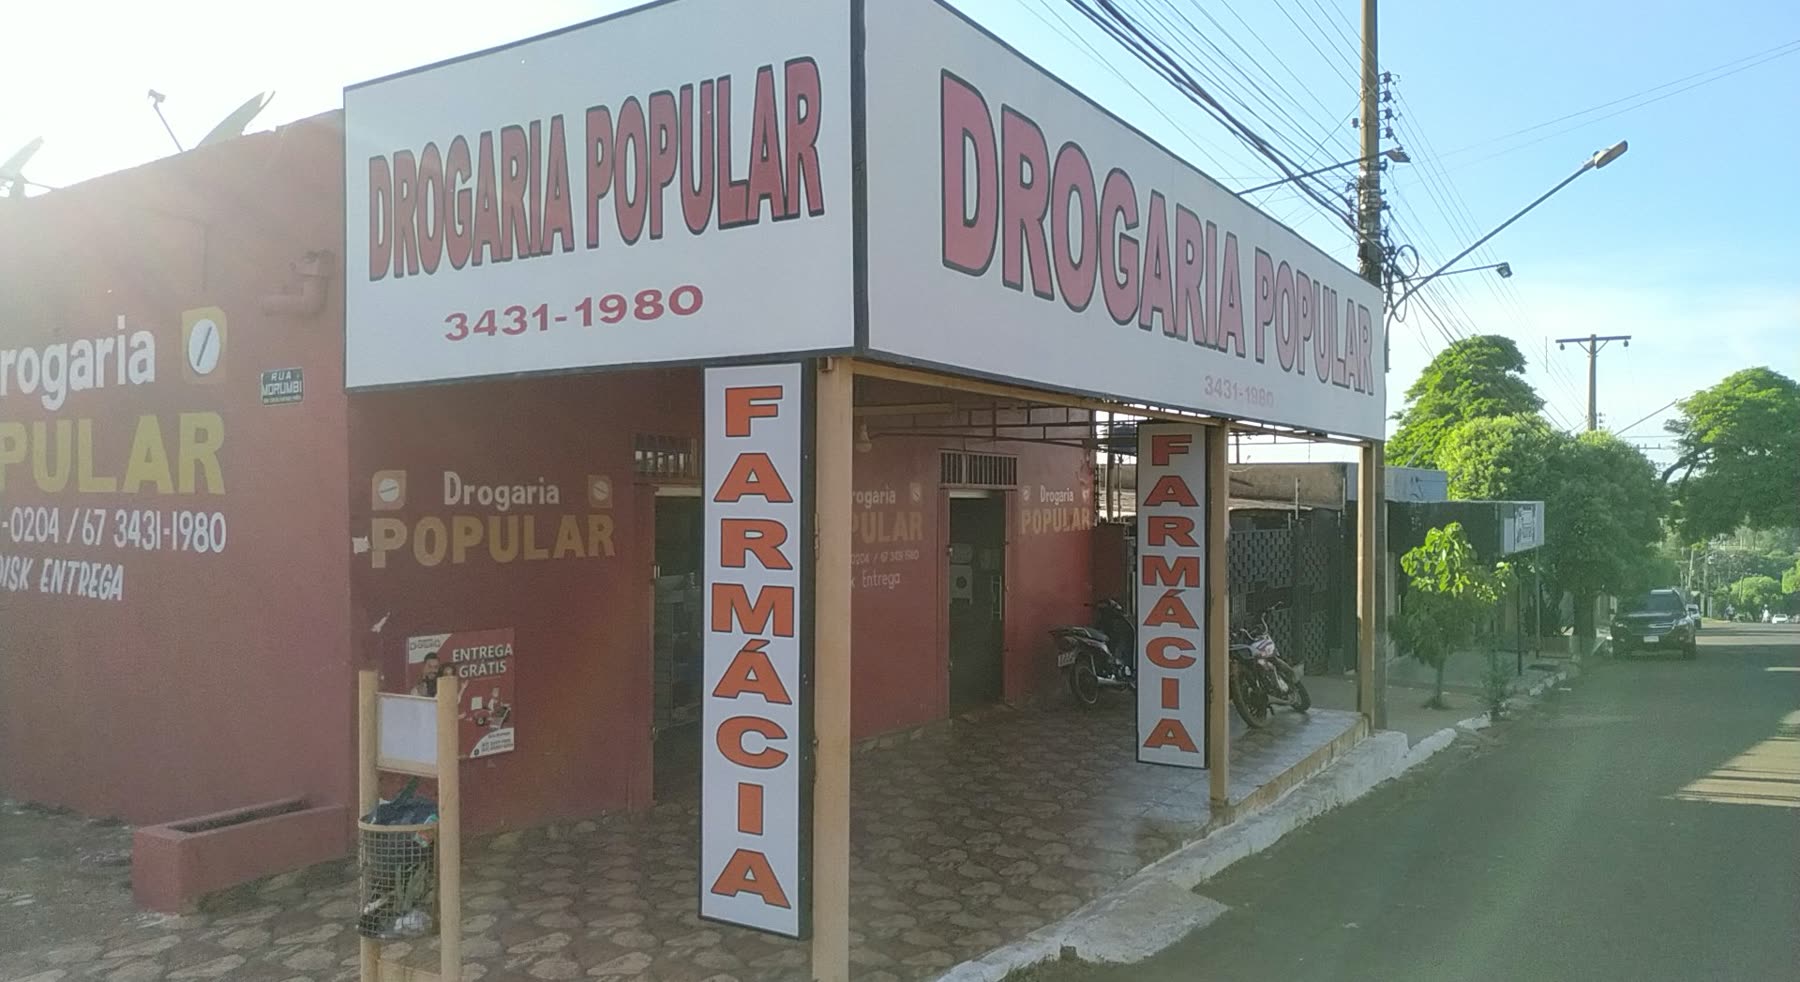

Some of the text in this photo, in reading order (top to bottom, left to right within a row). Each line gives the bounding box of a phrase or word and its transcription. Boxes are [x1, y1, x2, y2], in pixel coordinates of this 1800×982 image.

[368, 55, 826, 281] DROGARIA POPULAR
[940, 67, 1375, 397] DROGARIA POPULAR
[444, 285, 705, 342] 3431-1980
[271, 371, 292, 381] RUA
[443, 471, 561, 511] Drogaria
[1040, 485, 1074, 506] Drogaria
[113, 508, 227, 553] 3431-1980
[371, 514, 616, 568] POPULAR
[1021, 507, 1090, 536] POPULAR
[40, 558, 124, 600] ENTREGA
[1141, 434, 1200, 754] FARMÁCIA
[452, 643, 513, 662] ENTREGA
[711, 385, 794, 910] FARMÁCIA
